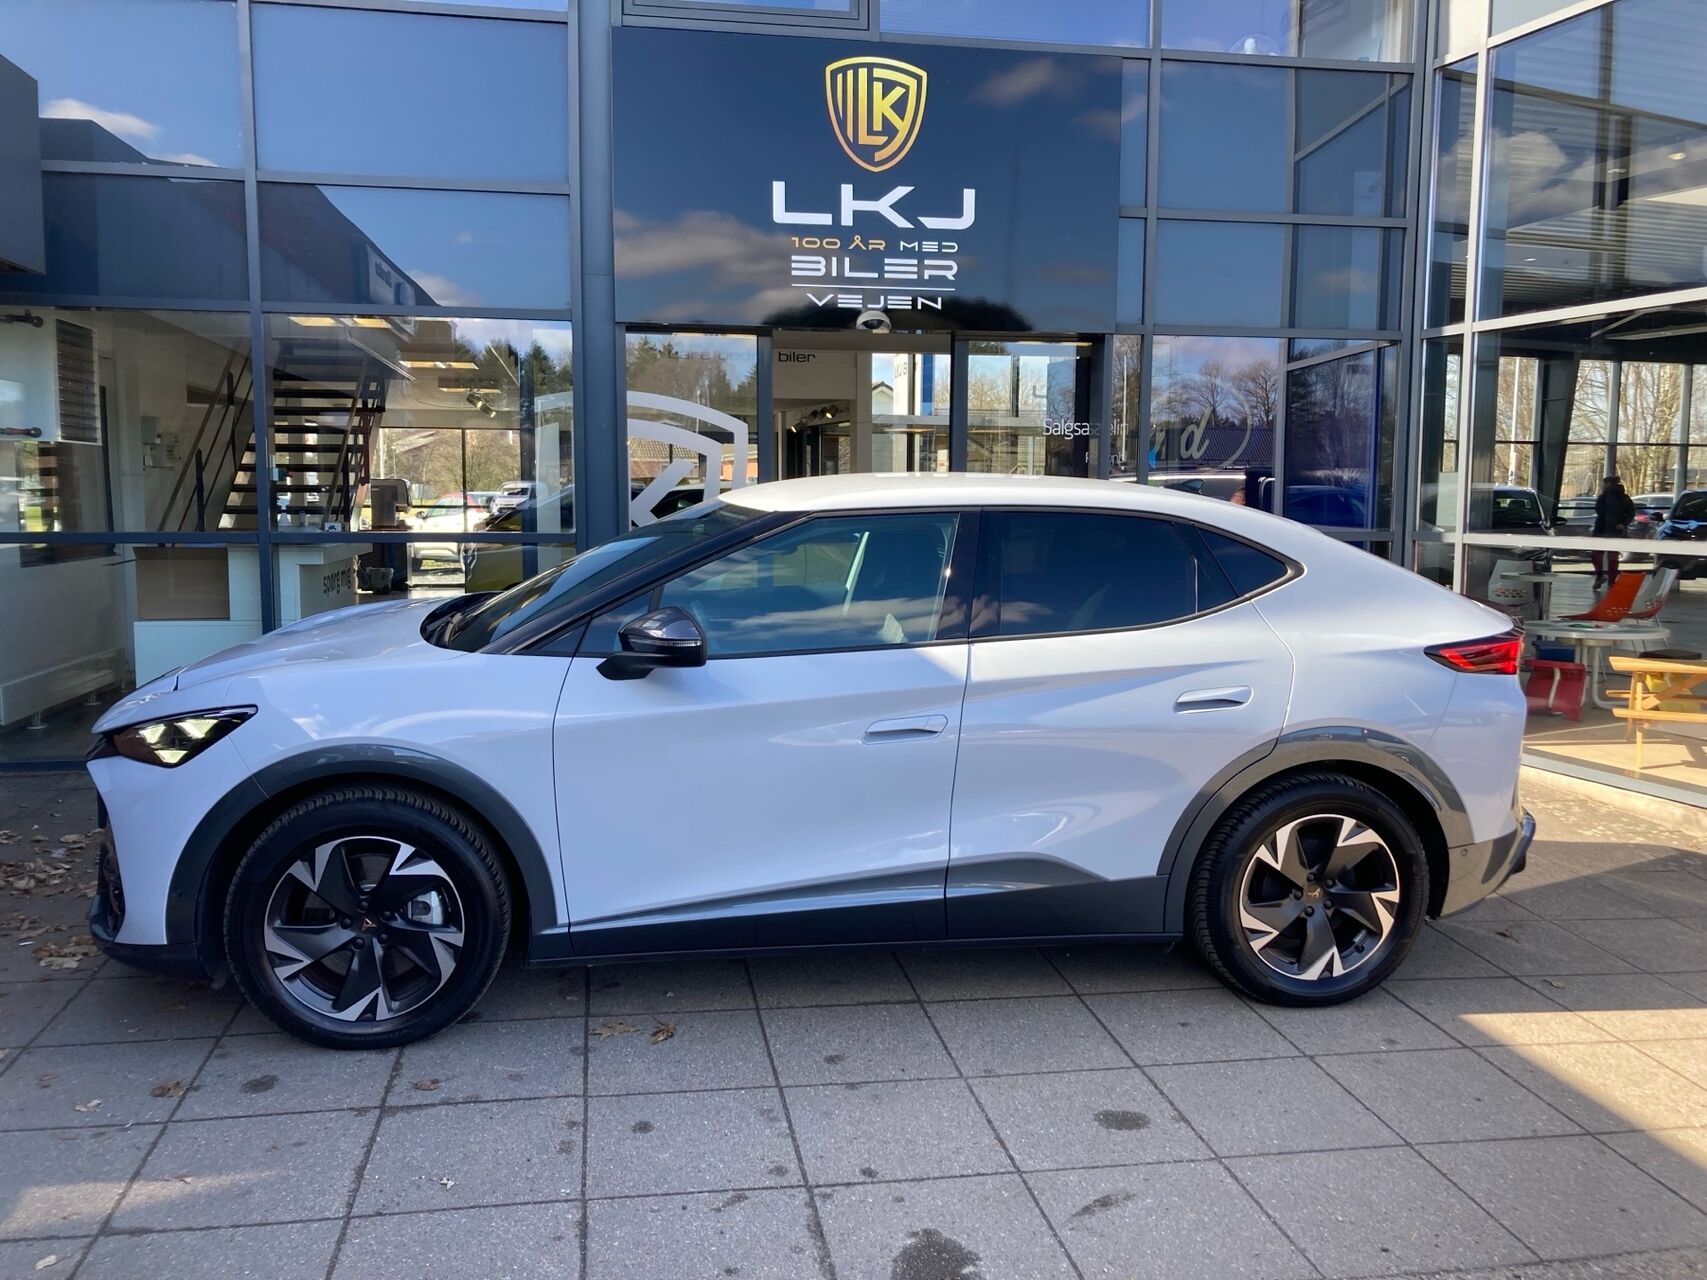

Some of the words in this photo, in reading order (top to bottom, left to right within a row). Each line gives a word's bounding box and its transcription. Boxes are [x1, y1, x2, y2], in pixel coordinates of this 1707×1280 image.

[772, 180, 976, 230] LKJ
[791, 236, 841, 249] 100
[848, 234, 886, 251] ÅR
[900, 240, 959, 253] MED
[791, 255, 959, 281] BILER
[806, 292, 942, 310] VEJEN
[778, 351, 816, 363] biler
